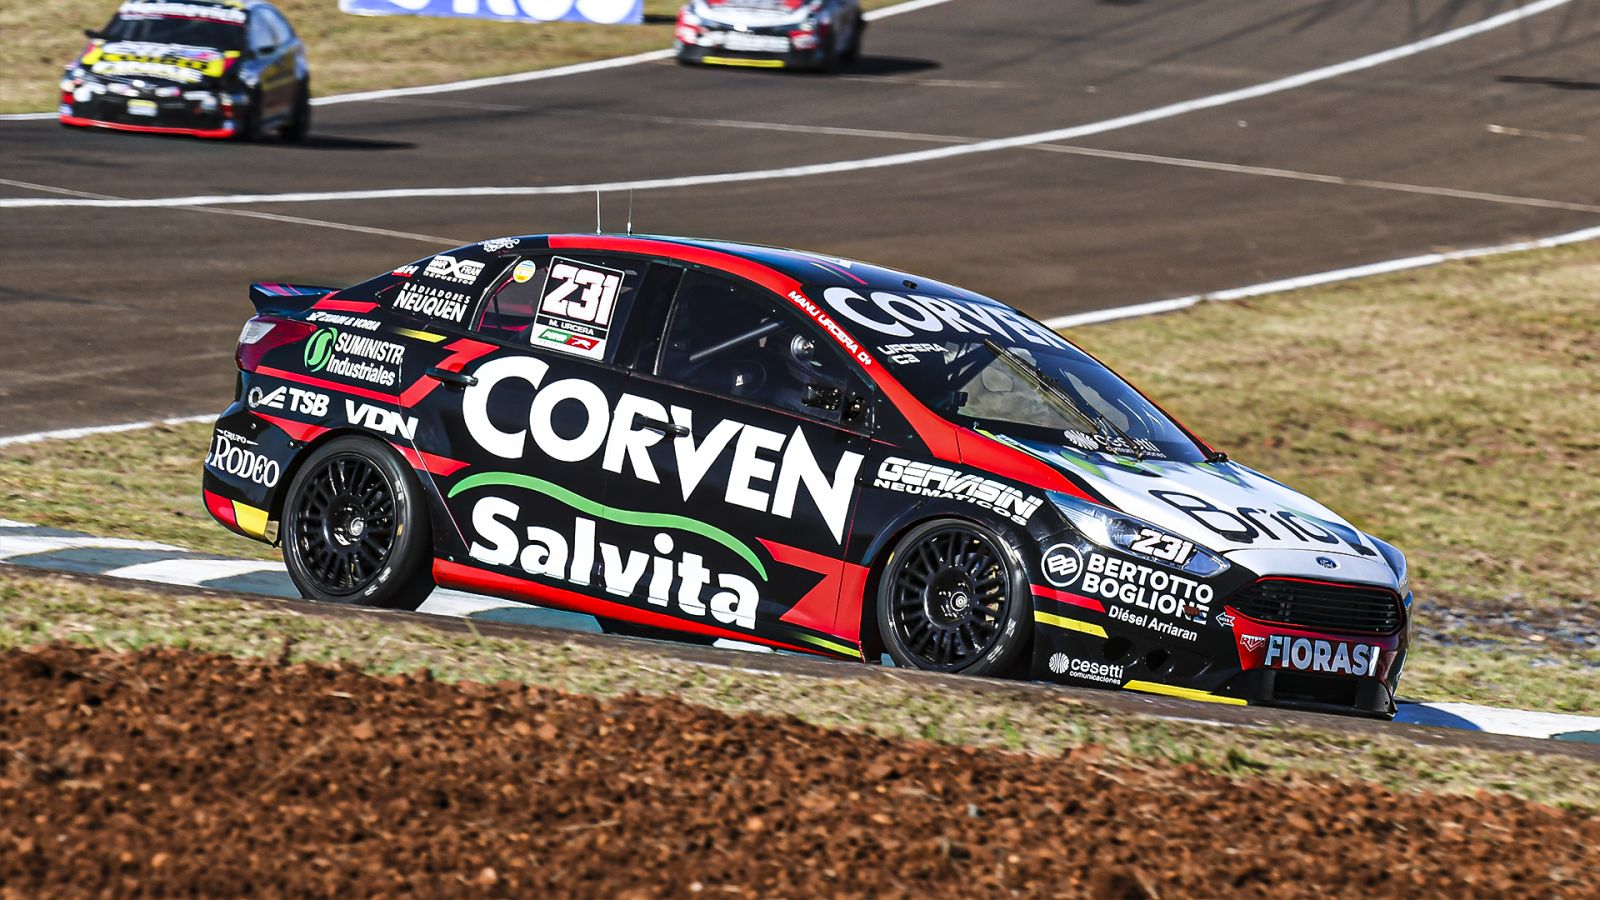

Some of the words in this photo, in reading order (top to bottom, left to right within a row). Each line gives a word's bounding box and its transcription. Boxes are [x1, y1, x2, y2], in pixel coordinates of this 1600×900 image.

[393, 290, 468, 323] NEUQUEN
[403, 282, 472, 304] RADIADORES
[541, 263, 620, 325] 231
[560, 322, 594, 336] URCERA
[787, 290, 820, 317] MANU
[817, 314, 859, 354] URCERA
[823, 286, 1074, 353] CORVEN
[325, 354, 396, 386] Industriales
[876, 343, 949, 356] URCERA
[344, 399, 419, 440] VDN
[210, 434, 280, 488] RODEO
[461, 355, 865, 547] CORVEN
[873, 478, 1028, 527] NEUMATICOS
[467, 496, 761, 630] Salvita
[1129, 527, 1194, 564] 231
[1086, 552, 1214, 601] BERTOTTO
[1081, 575, 1211, 626] BOGLIONE
[1108, 604, 1149, 628] Diésel
[1147, 617, 1198, 642] Arriaran
[1070, 657, 1124, 679] cesetti
[1264, 634, 1381, 677] FIORASI
[1069, 669, 1121, 685] comunicaciones
